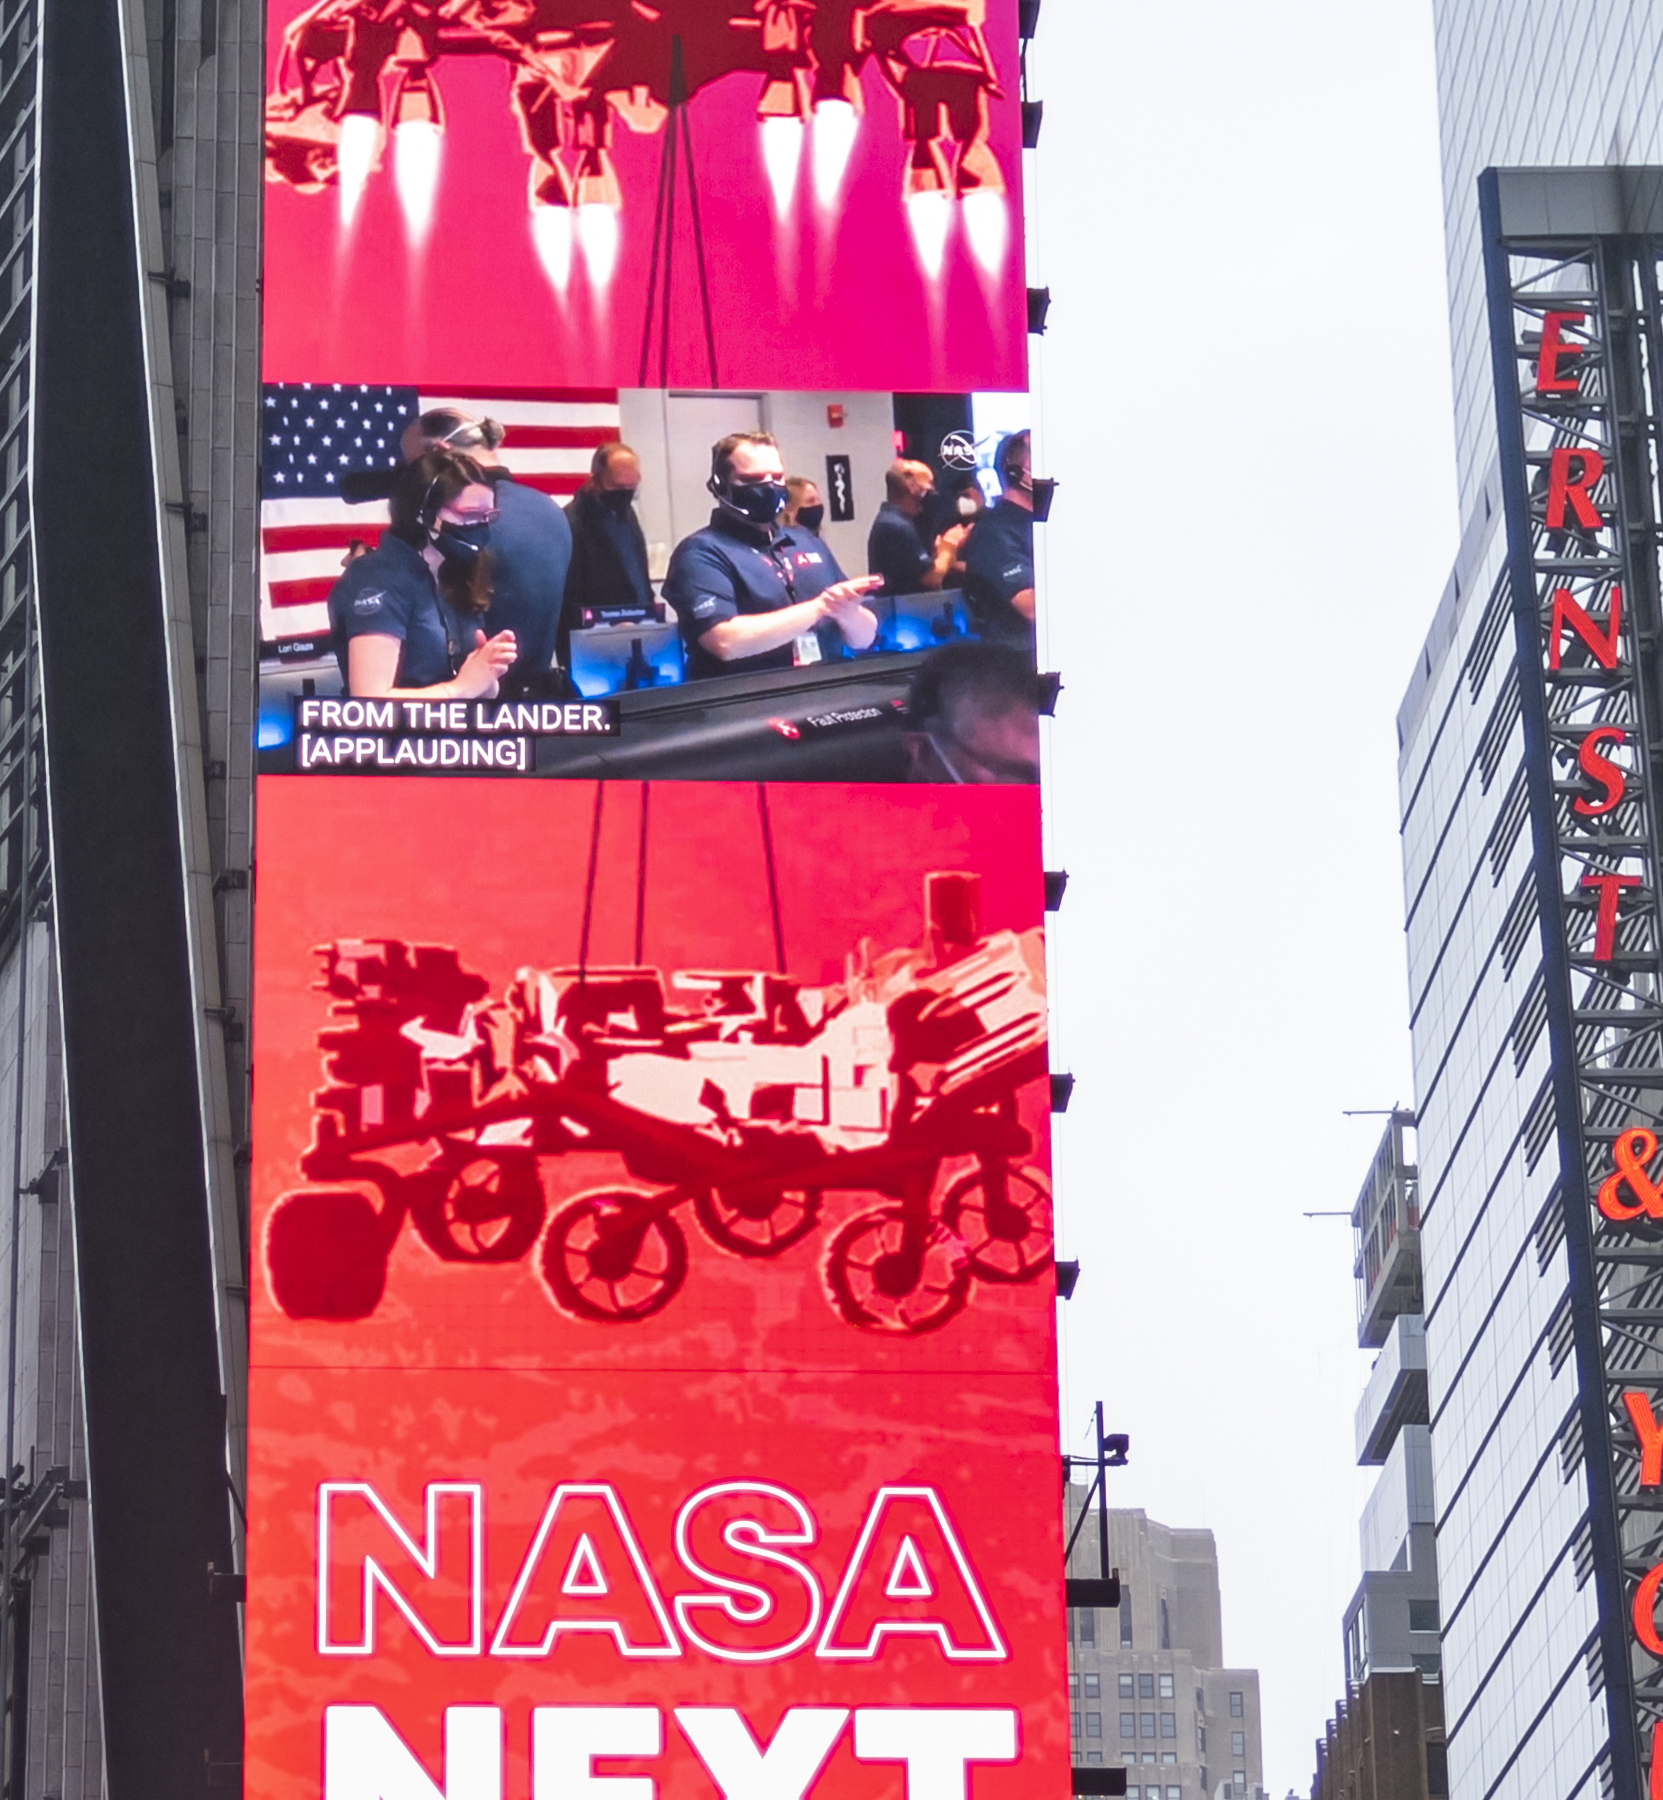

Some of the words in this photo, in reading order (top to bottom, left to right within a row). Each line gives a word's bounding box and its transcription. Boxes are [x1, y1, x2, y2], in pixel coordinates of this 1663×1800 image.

[1536, 310, 1641, 961] ERNST
[301, 734, 526, 770] [APPLAUDING]
[302, 700, 393, 729] FROM
[402, 702, 468, 730] THE
[476, 703, 611, 731] LANDER.
[317, 1481, 1007, 1661] NASA
